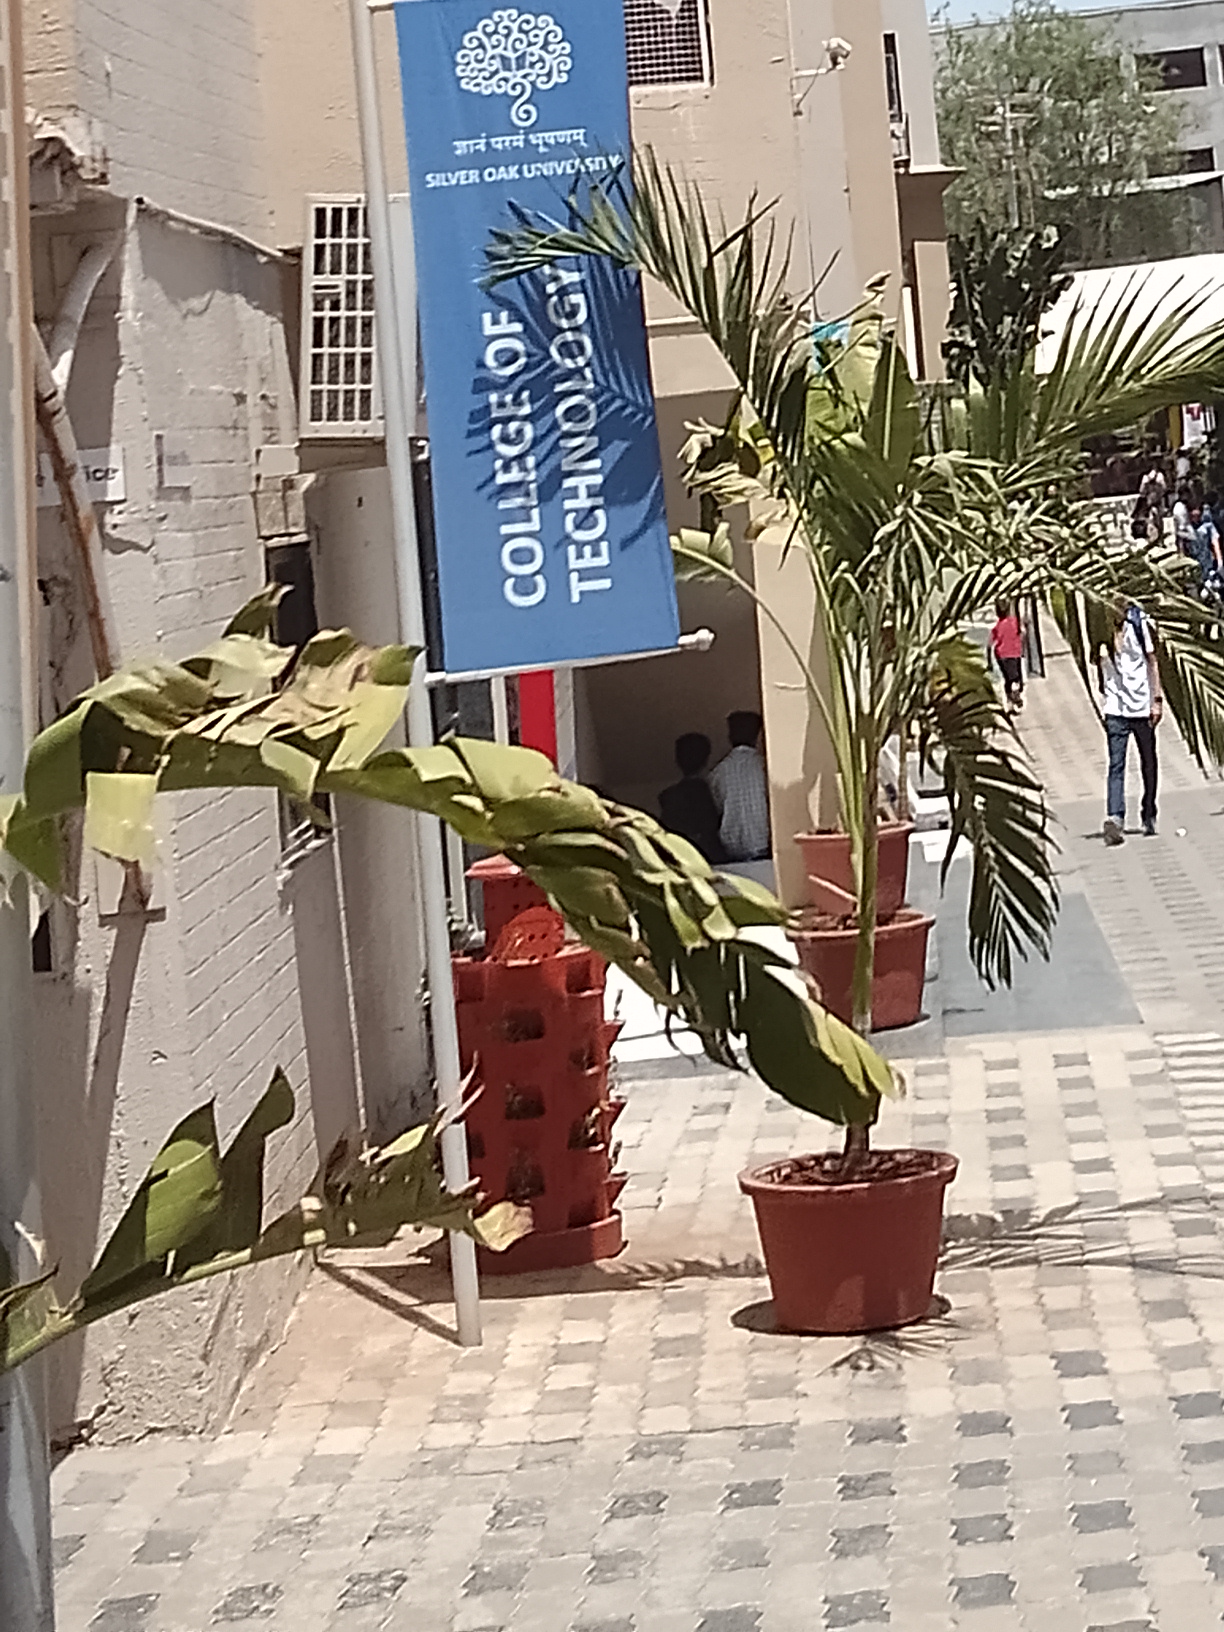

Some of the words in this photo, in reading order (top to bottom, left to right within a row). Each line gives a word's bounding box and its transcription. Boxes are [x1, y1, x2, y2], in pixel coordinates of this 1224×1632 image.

[491, 130, 525, 151] परमं
[425, 170, 480, 188] SILVER
[483, 165, 520, 182] OAK
[482, 309, 528, 377] OF
[543, 264, 613, 604] TECHNOLOGY
[489, 389, 547, 608] COLLEGE
